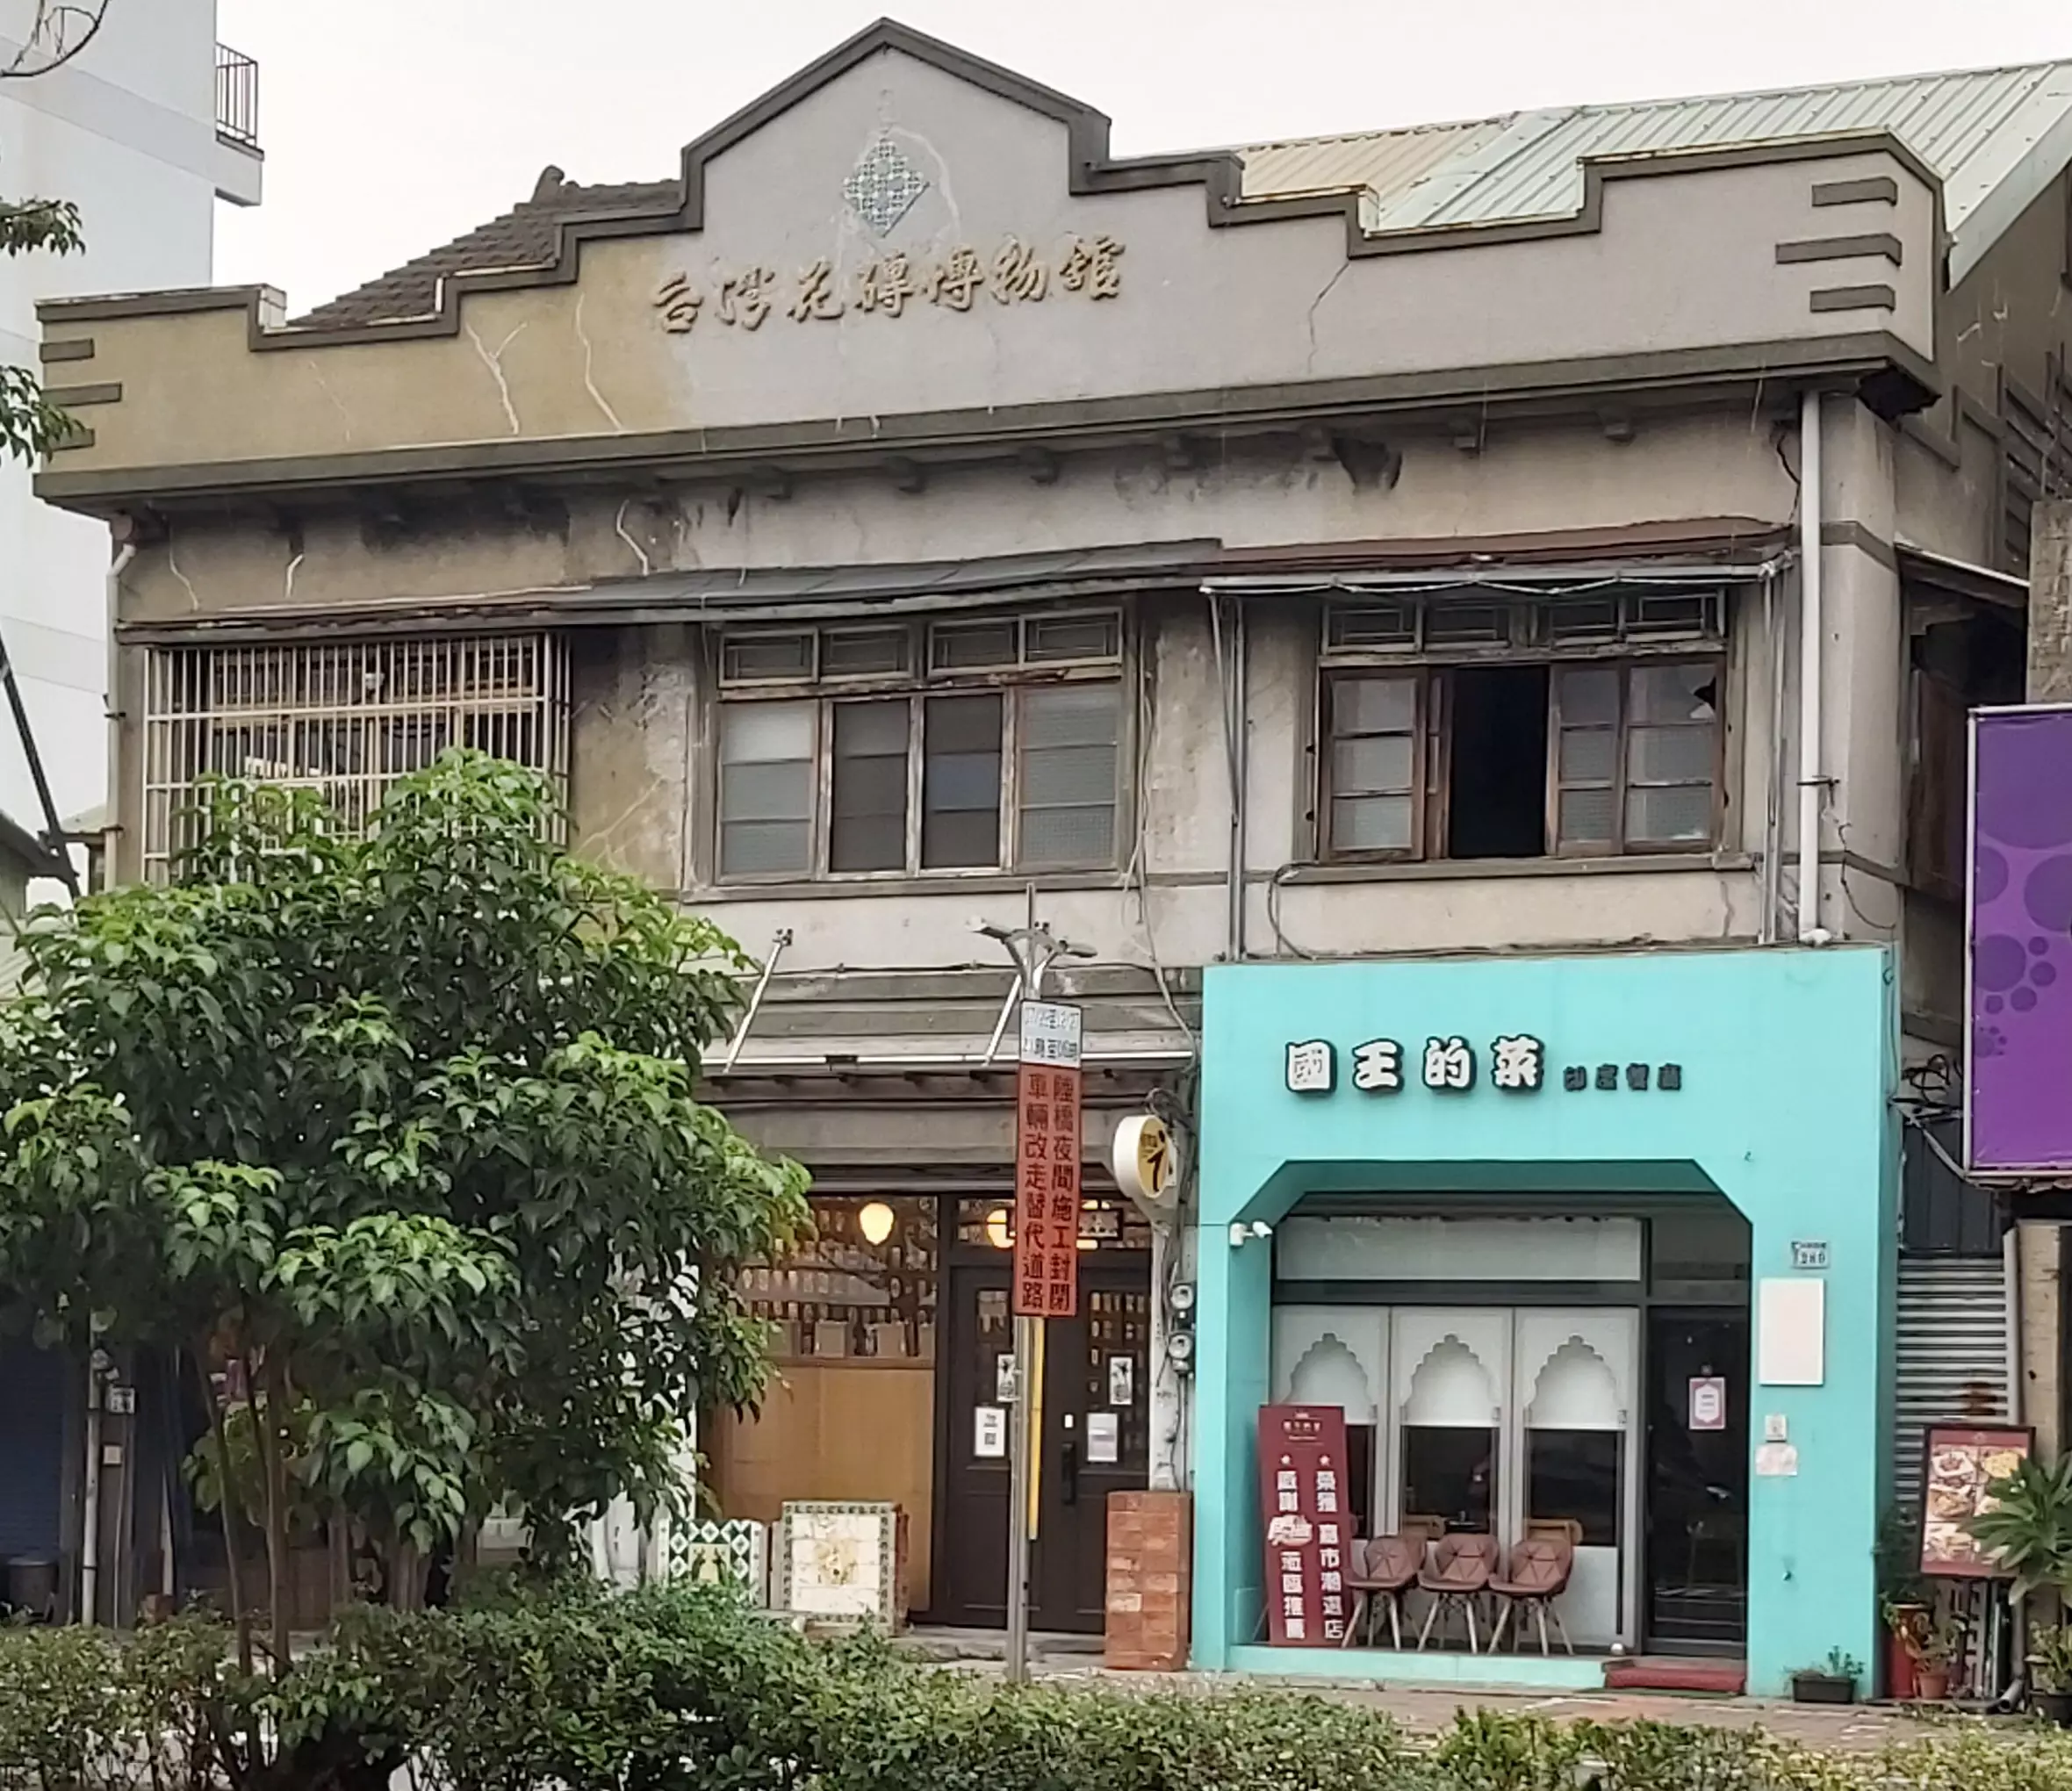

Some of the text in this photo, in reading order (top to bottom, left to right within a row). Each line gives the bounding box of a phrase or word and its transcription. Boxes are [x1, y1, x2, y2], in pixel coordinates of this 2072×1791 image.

[1285, 1033, 1546, 1092] 國王的菜
[1021, 1073, 1049, 1310] 車輛改走替代道路
[1049, 1073, 1075, 1313] 陸橋夜間施工封閉
